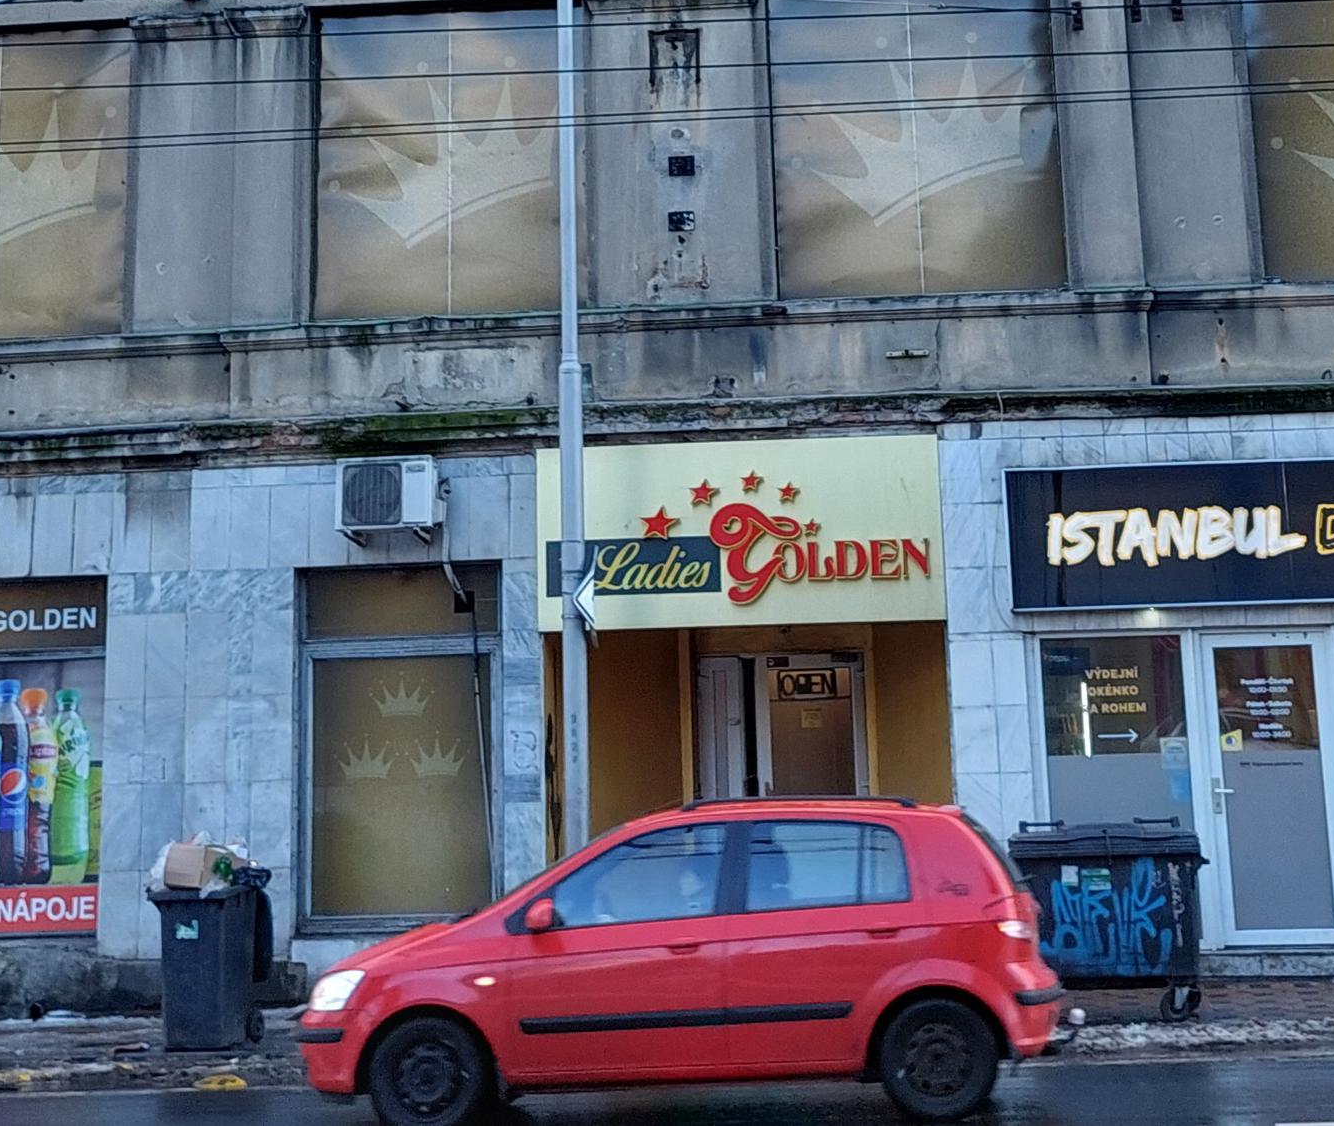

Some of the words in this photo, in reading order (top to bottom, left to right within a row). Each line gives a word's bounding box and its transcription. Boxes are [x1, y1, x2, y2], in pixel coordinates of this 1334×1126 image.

[596, 541, 713, 591] Ladies
[709, 502, 930, 606] GOLDEN
[1046, 505, 1308, 568] ISTANBUL
[1084, 665, 1139, 680] VÝDEJNÍ
[1100, 701, 1148, 714] ROHEM
